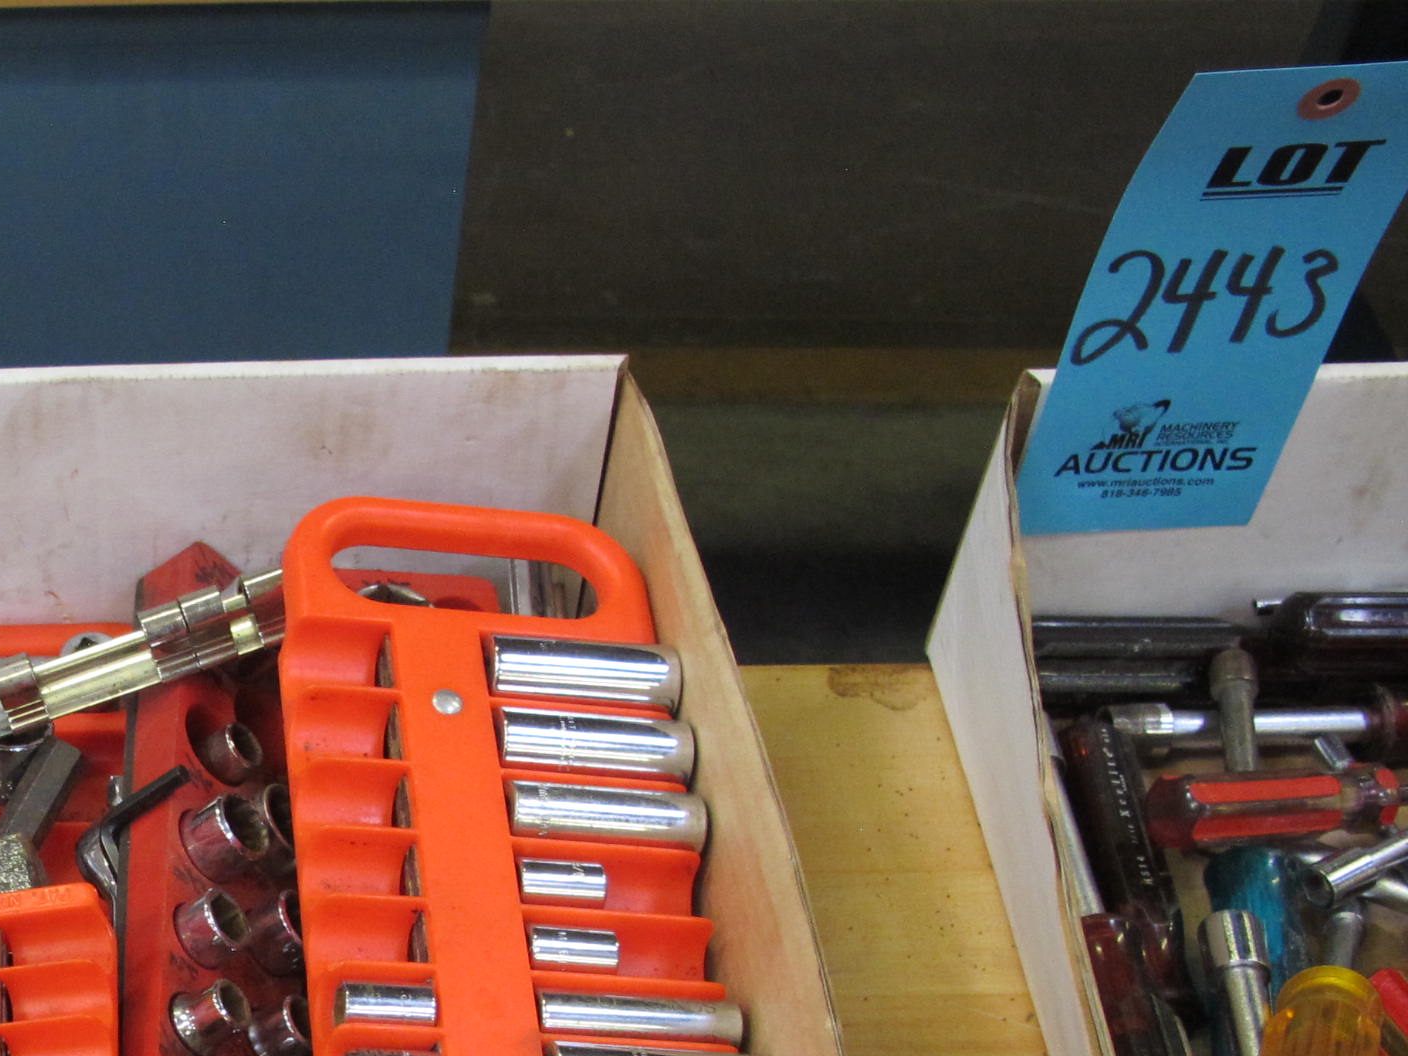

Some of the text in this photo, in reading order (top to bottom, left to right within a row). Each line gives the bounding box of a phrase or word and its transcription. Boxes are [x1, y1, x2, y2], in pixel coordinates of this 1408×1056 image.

[1206, 139, 1387, 189] LOT
[1070, 246, 1339, 365] 2443
[1160, 421, 1240, 432] MACHINERY
[1107, 431, 1149, 450] MRI
[1156, 431, 1234, 441] RESOURCES
[1053, 447, 1257, 477] AUCTIONS
[1077, 476, 1215, 489] www.mriauctions.com
[1101, 487, 1182, 499] 818-346-7985
